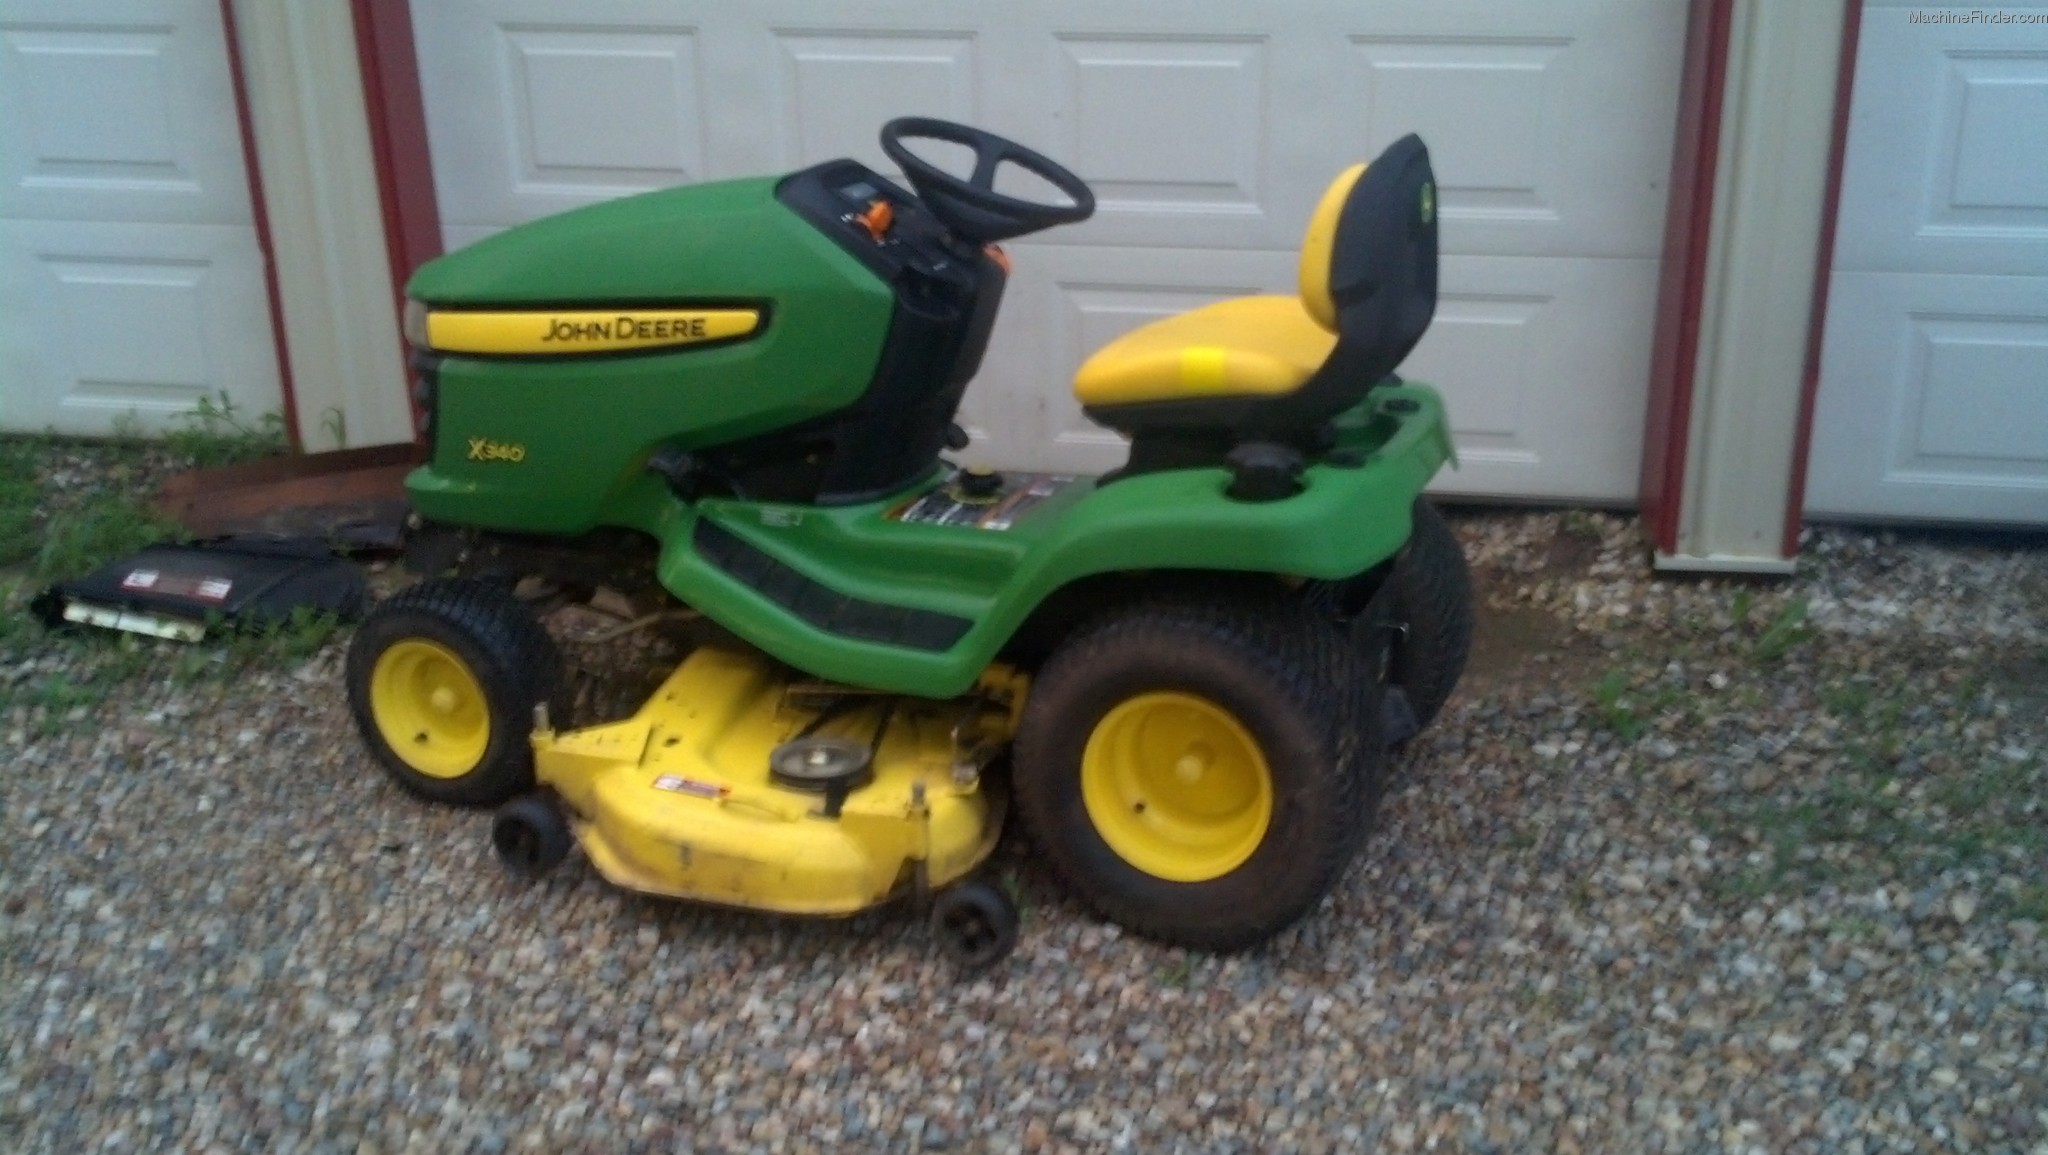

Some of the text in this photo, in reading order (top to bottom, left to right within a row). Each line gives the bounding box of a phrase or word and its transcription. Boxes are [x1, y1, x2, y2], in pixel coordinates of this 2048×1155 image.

[541, 316, 707, 342] JOHN DEERE
[467, 438, 525, 462] X340
